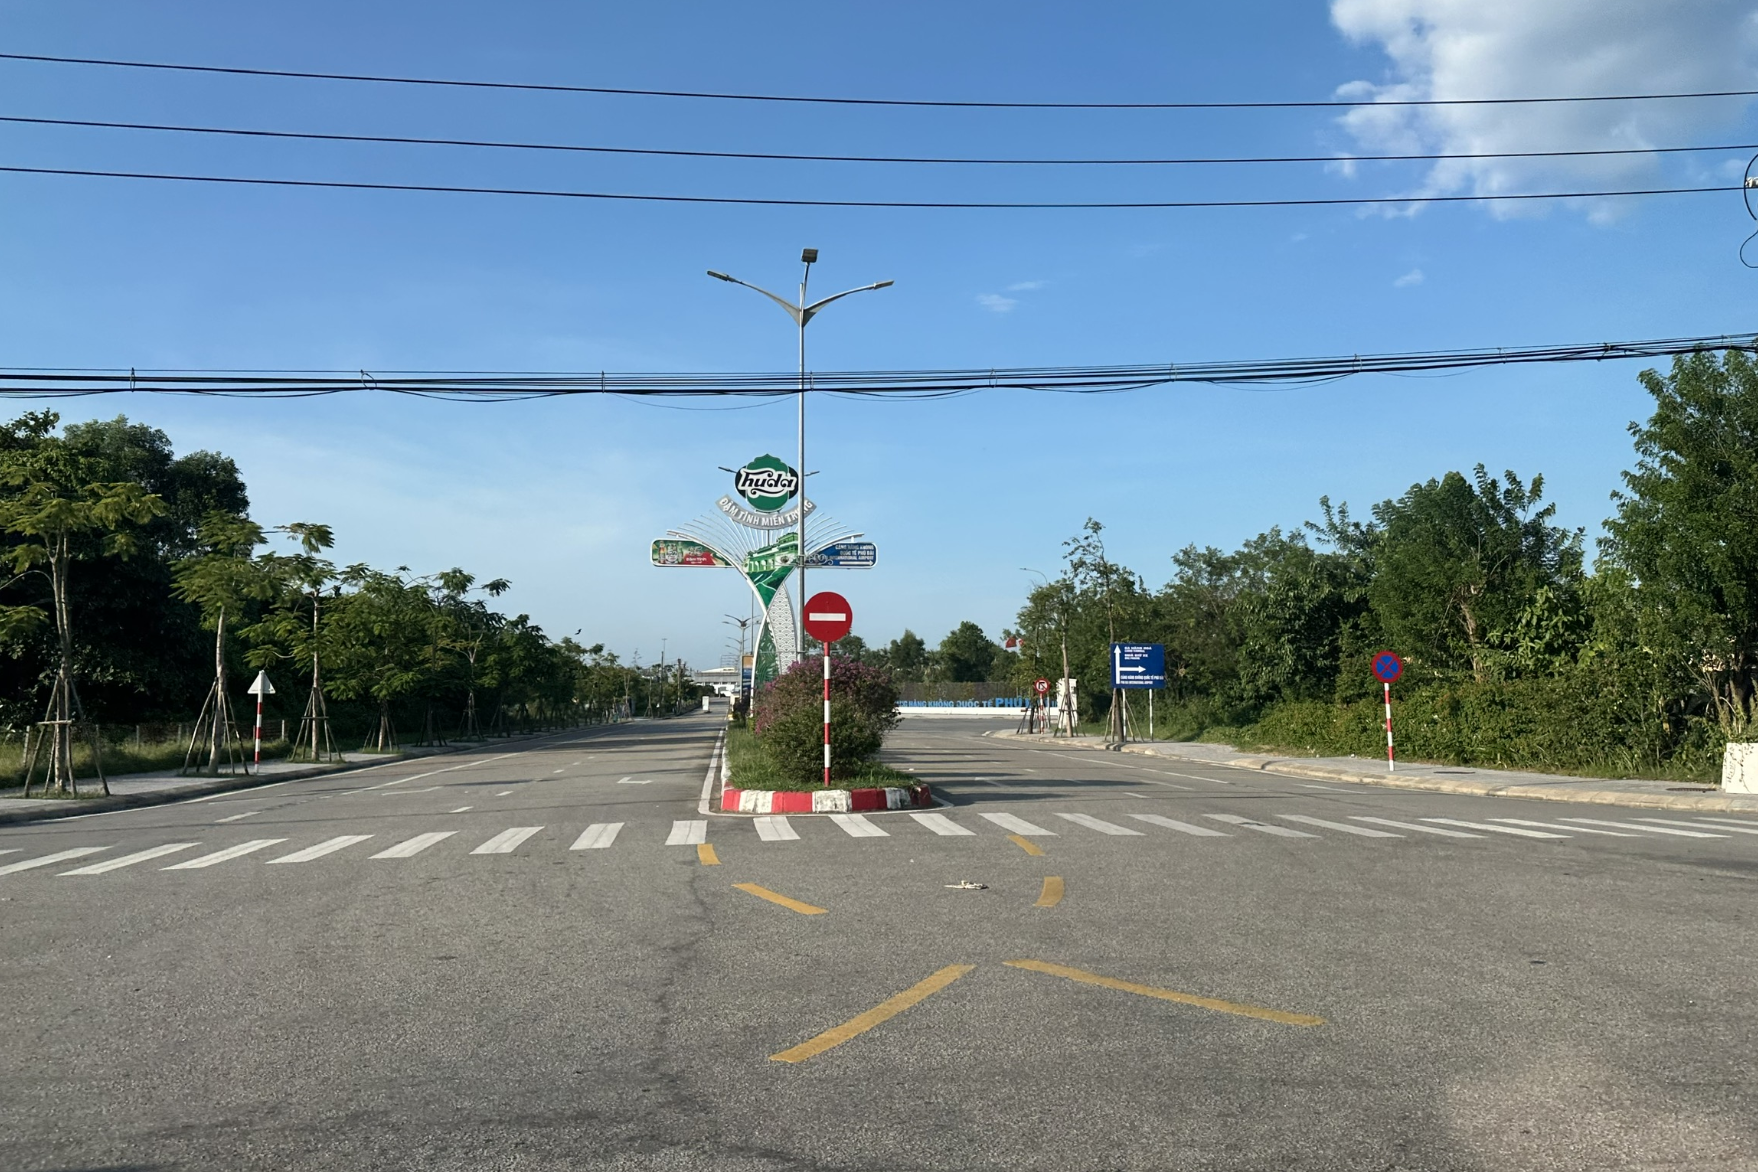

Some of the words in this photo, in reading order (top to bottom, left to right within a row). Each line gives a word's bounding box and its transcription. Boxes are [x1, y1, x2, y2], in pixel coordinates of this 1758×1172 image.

[740, 470, 796, 494] huda
[719, 497, 739, 517] ĐẬM
[738, 512, 759, 526] TÌNH
[928, 698, 954, 707] KHÔNG
